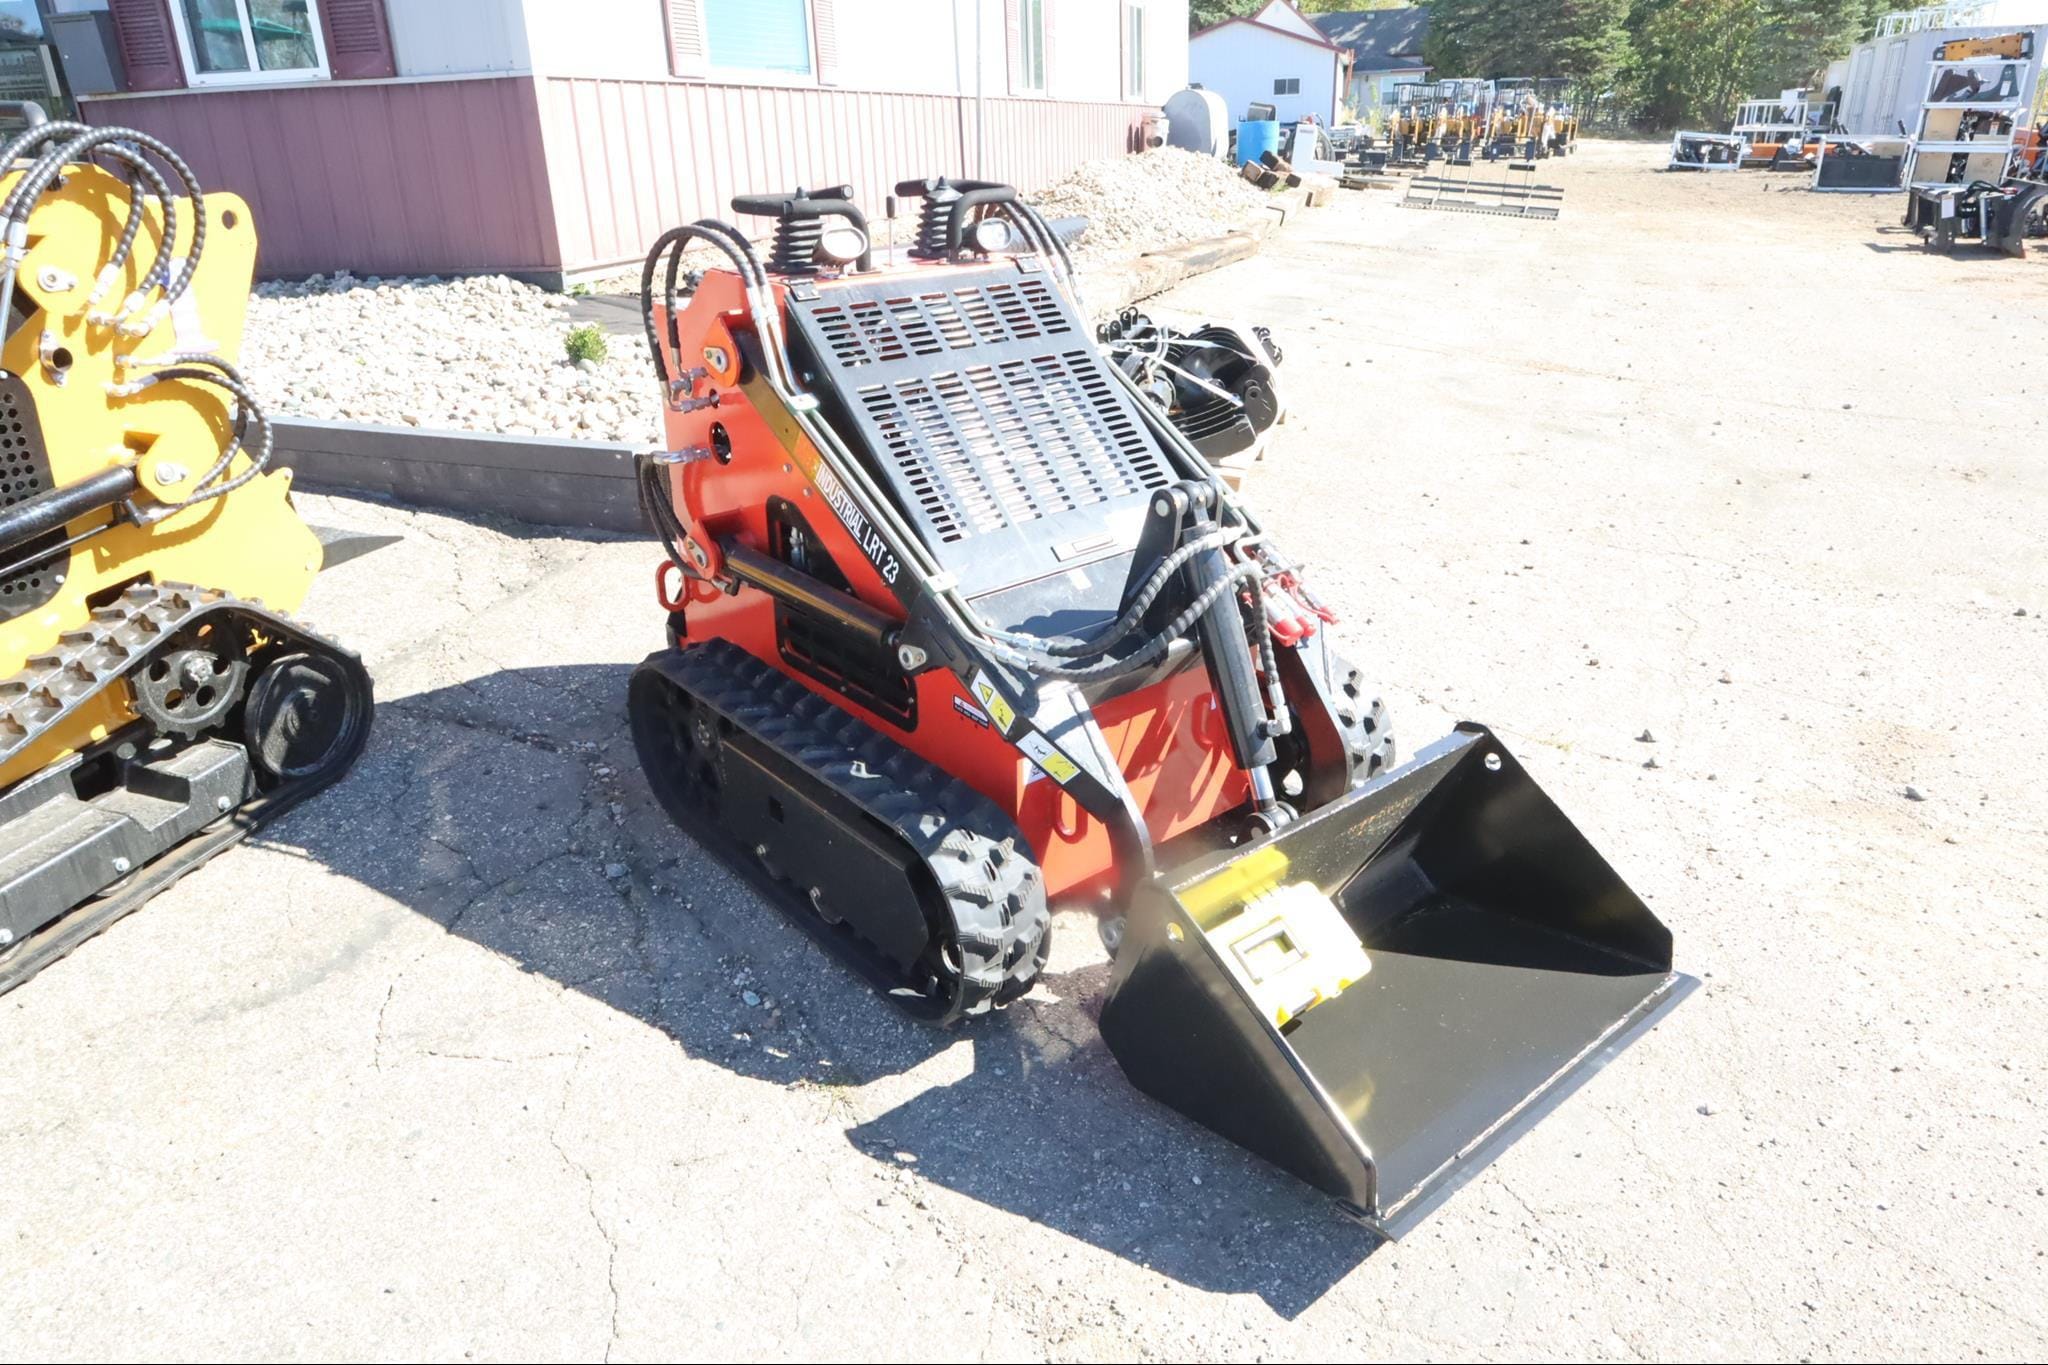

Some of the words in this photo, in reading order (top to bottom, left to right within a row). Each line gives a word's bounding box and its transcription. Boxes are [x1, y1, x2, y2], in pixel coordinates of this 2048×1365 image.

[815, 463, 864, 538] INDUSTRIAL
[863, 526, 887, 565] LRT
[882, 554, 900, 584] 23
